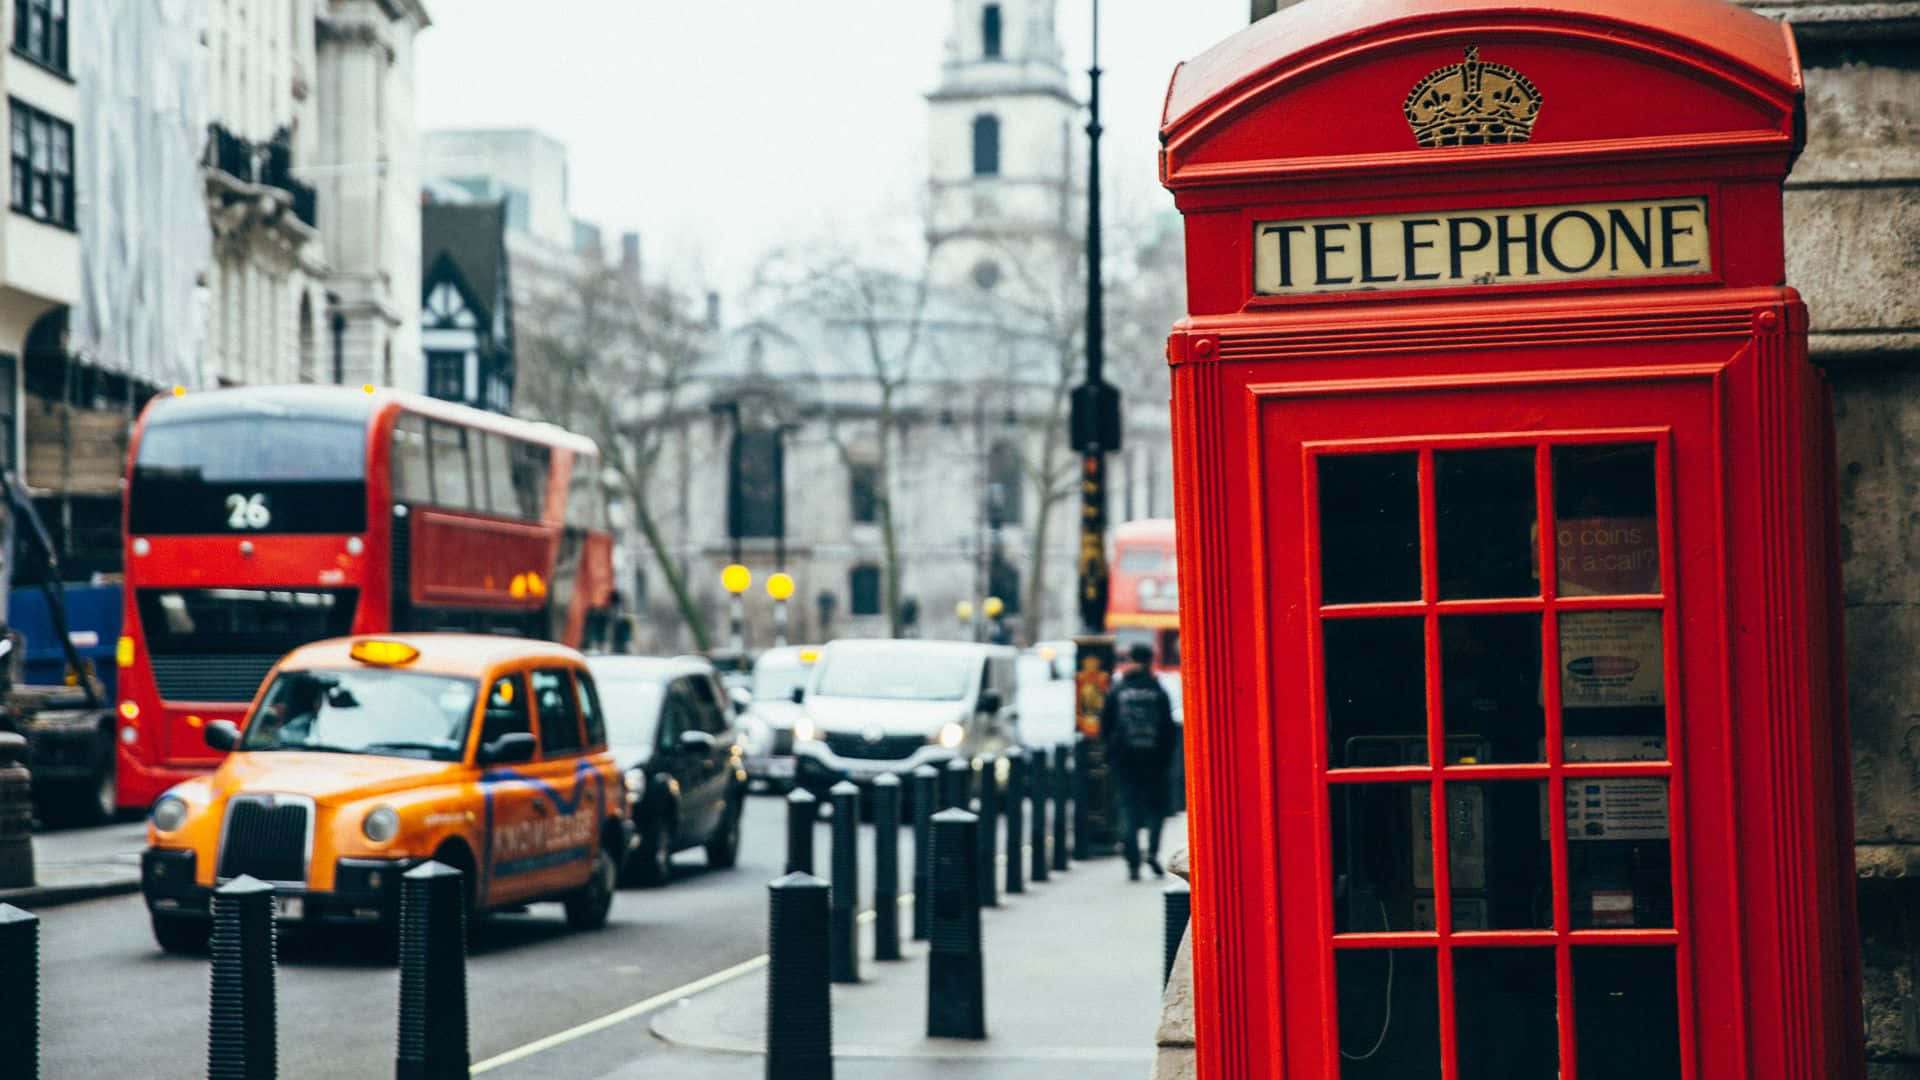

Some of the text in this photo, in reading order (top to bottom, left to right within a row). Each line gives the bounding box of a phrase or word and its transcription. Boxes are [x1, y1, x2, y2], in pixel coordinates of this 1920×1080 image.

[1262, 203, 1701, 288] TELEPHONE
[226, 492, 271, 529] 26
[1580, 527, 1642, 546] coins
